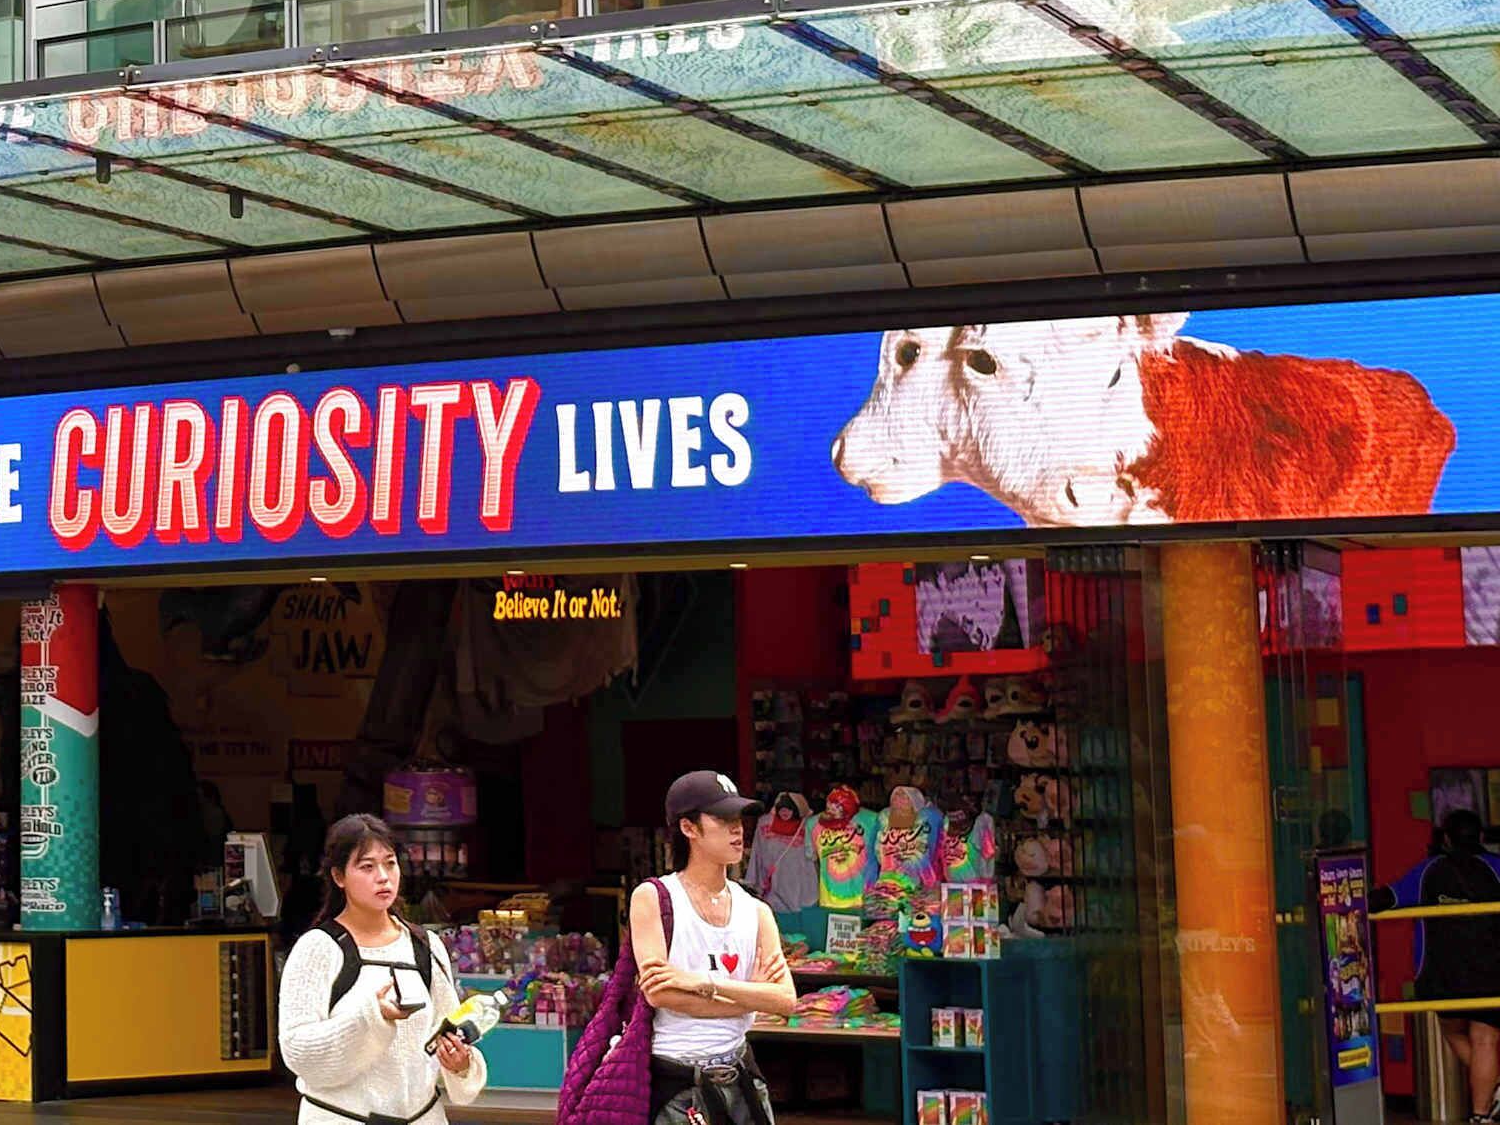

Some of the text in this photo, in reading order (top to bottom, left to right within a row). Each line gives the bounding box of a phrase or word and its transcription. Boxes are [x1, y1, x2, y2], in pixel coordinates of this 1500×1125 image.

[50, 377, 538, 549] CURIOSITY
[556, 392, 752, 493] LIVES
[284, 594, 348, 622] SHARK
[493, 590, 549, 620] Believe
[552, 589, 567, 619] It
[569, 596, 588, 619] or
[294, 628, 373, 674] JAW
